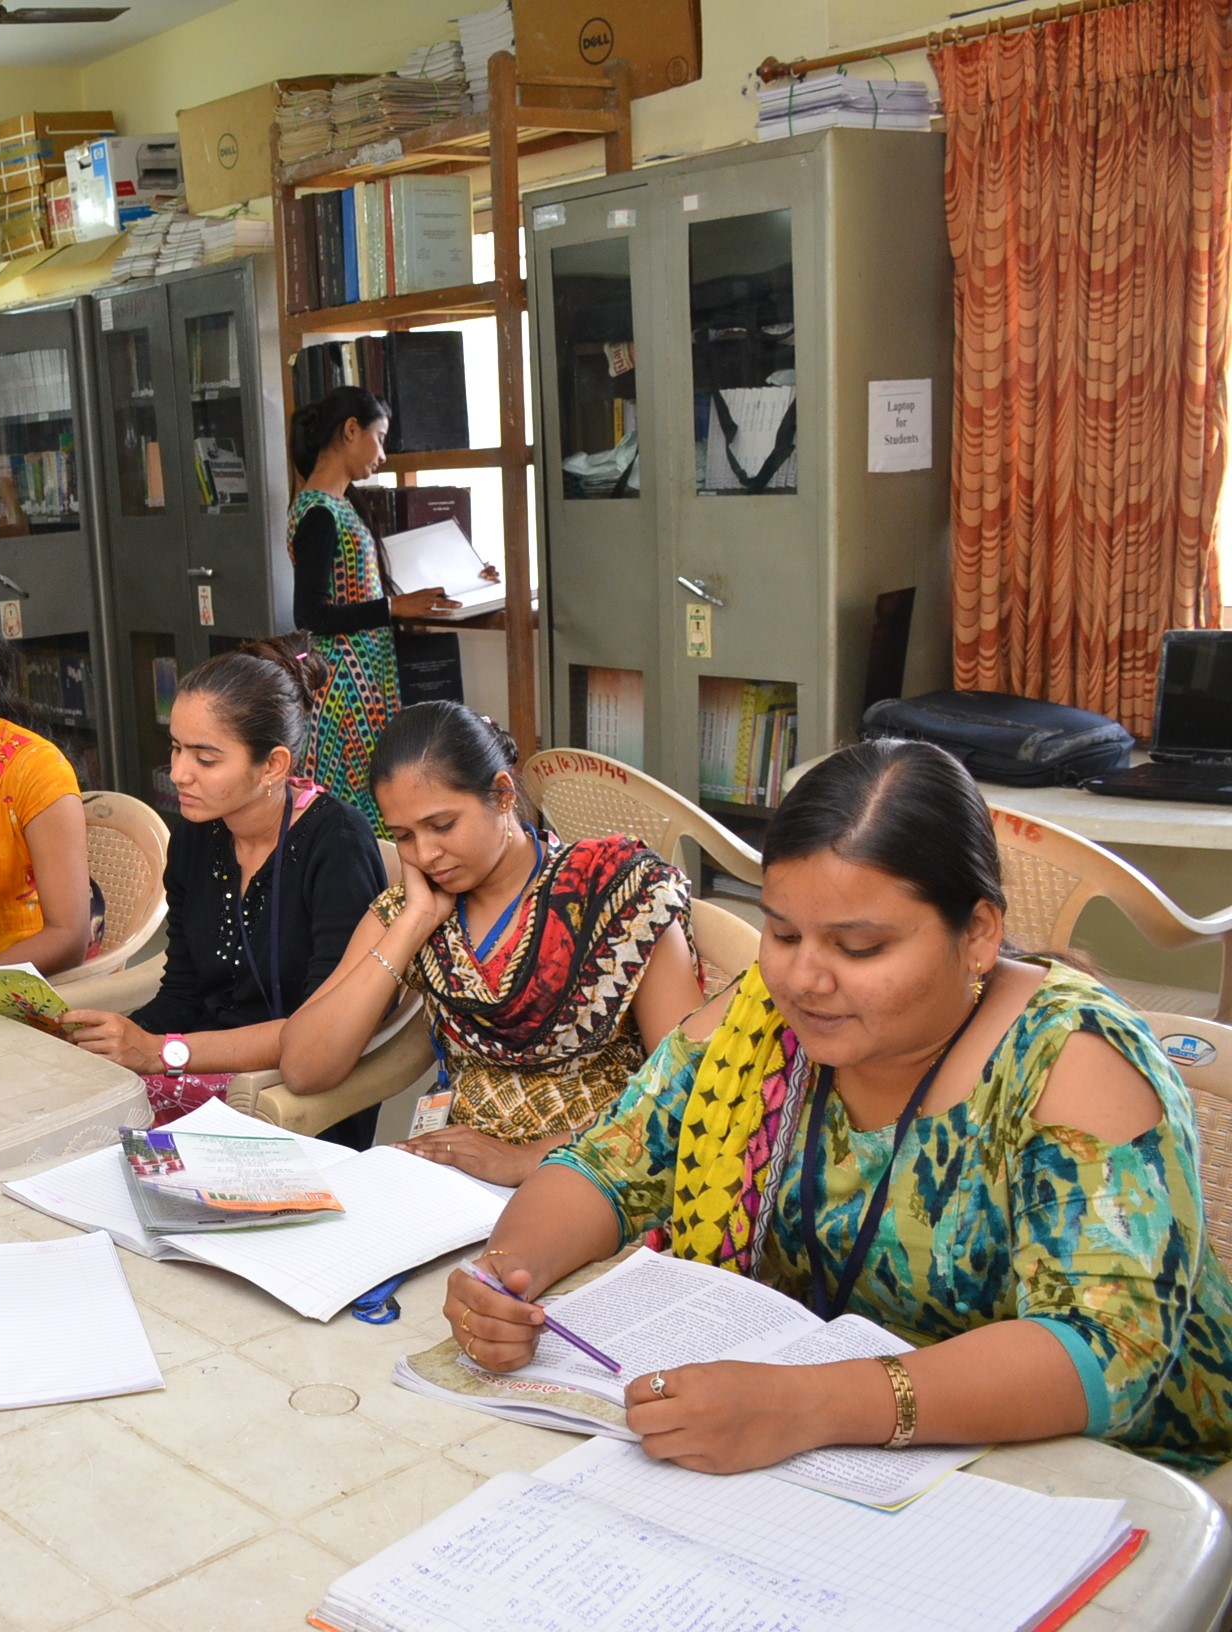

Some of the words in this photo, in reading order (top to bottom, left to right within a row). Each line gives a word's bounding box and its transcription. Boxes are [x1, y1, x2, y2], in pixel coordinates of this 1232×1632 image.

[582, 32, 610, 50] DELL
[219, 145, 237, 158] DELL
[887, 400, 916, 414] Laptop
[895, 416, 908, 428] for
[883, 433, 920, 446] Students
[1168, 1046, 1201, 1059] Nilkama
